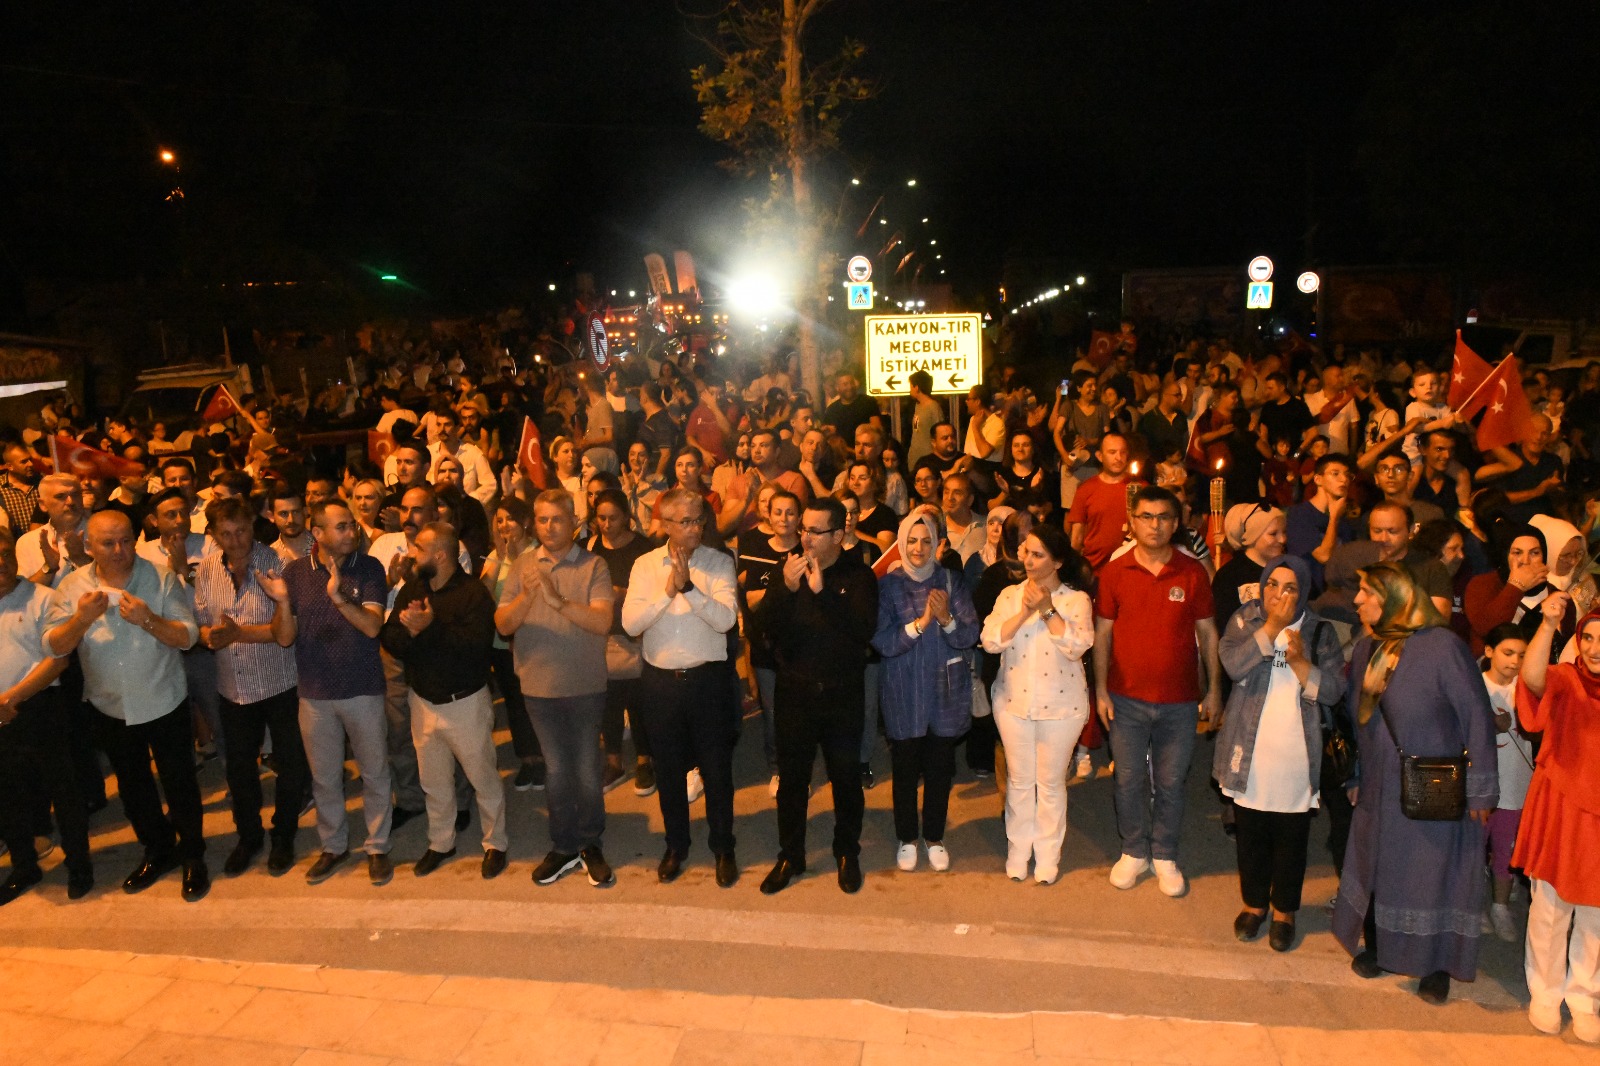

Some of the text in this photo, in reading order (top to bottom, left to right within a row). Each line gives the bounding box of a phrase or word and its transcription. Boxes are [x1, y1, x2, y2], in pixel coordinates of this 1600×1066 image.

[875, 321, 971, 336] KAMYON-TIR
[889, 336, 957, 354] MECBURİ
[880, 354, 967, 372] İSTİKAMETİ
